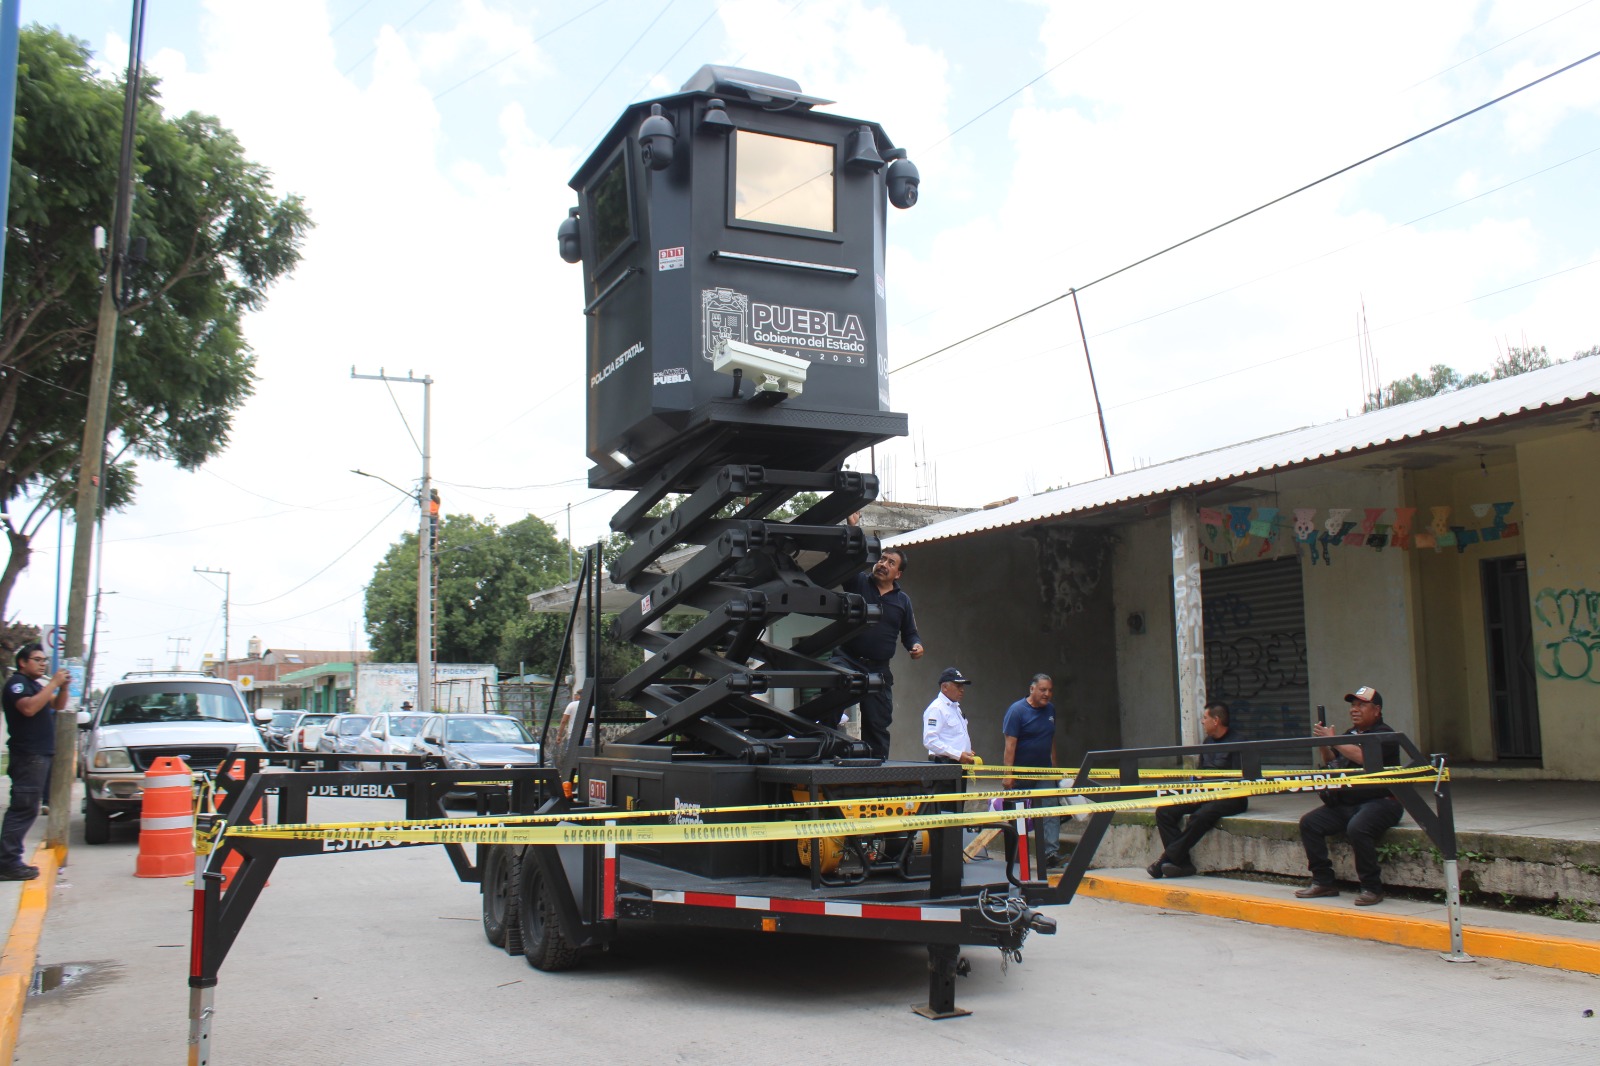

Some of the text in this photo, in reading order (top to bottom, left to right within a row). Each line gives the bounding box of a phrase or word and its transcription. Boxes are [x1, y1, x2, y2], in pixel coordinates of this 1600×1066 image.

[661, 249, 682, 259] 911
[752, 303, 865, 341] PUEBLA
[754, 330, 865, 352] Gobierno del Estado
[590, 341, 645, 389] POLICIA ESTATAL
[653, 373, 692, 386] PUEBLA
[341, 785, 396, 798] PUEBLA
[590, 783, 605, 799] 911
